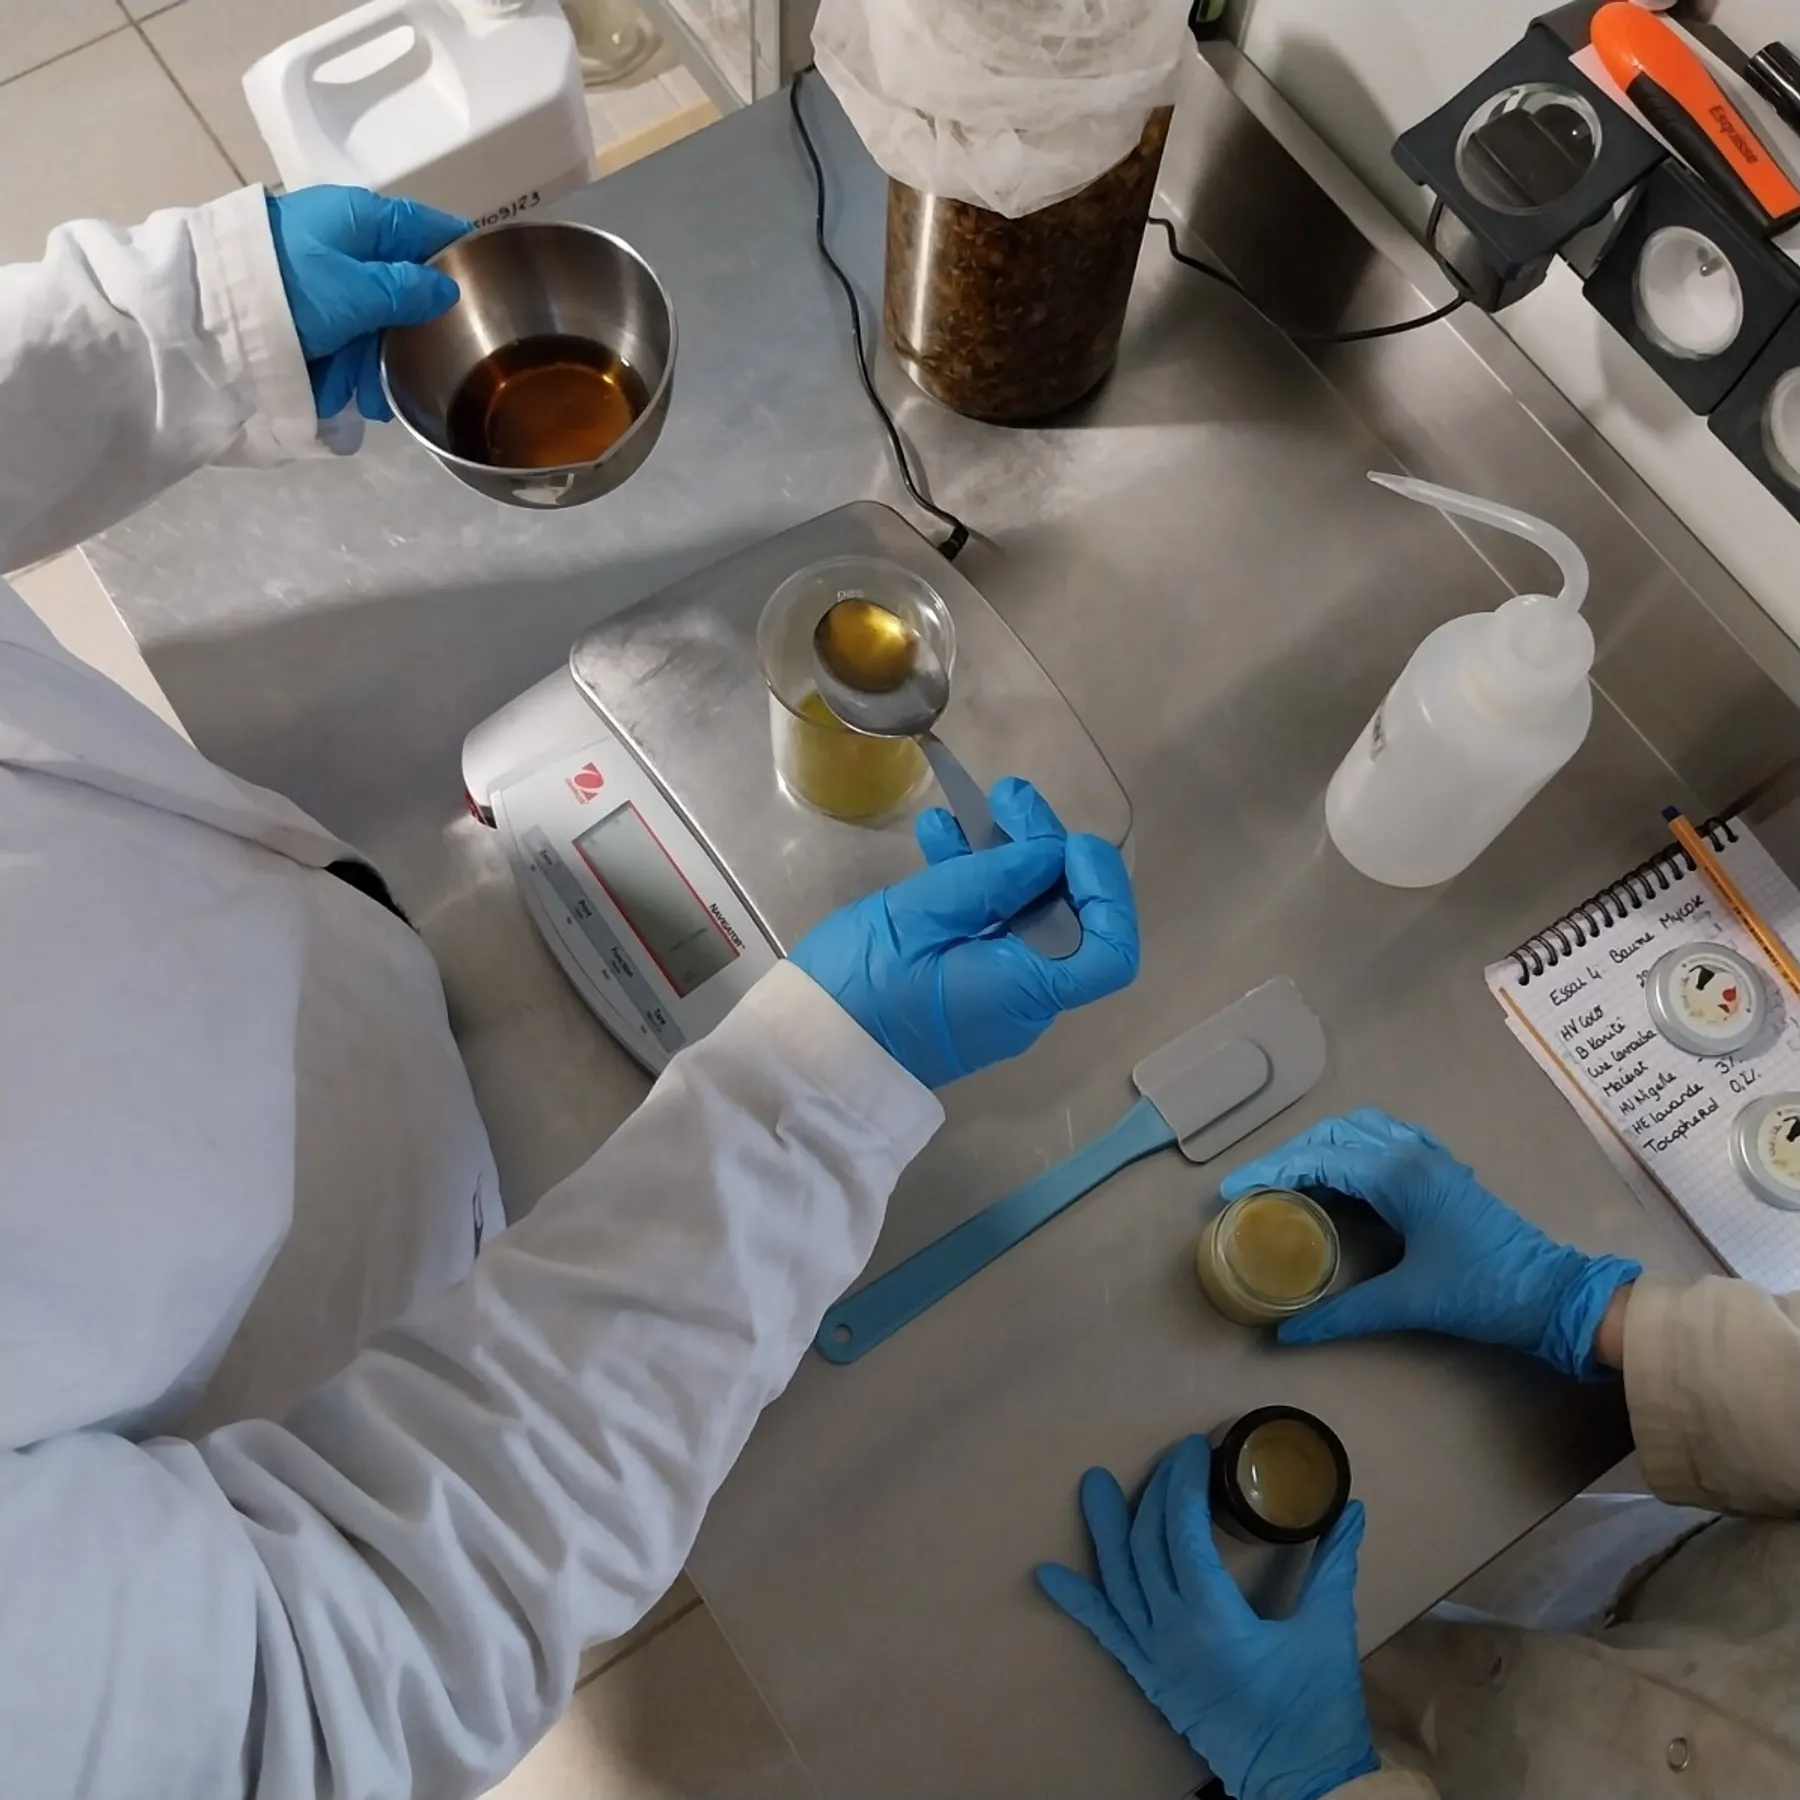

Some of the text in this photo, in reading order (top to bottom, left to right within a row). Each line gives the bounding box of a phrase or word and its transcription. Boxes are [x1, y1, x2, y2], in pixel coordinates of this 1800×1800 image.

[1709, 105, 1758, 164] Esquisse
[610, 946, 634, 978] Function
[1609, 932, 1656, 964] Baume
[1575, 1045, 1589, 1060] B
[1632, 1117, 1650, 1136] HE
